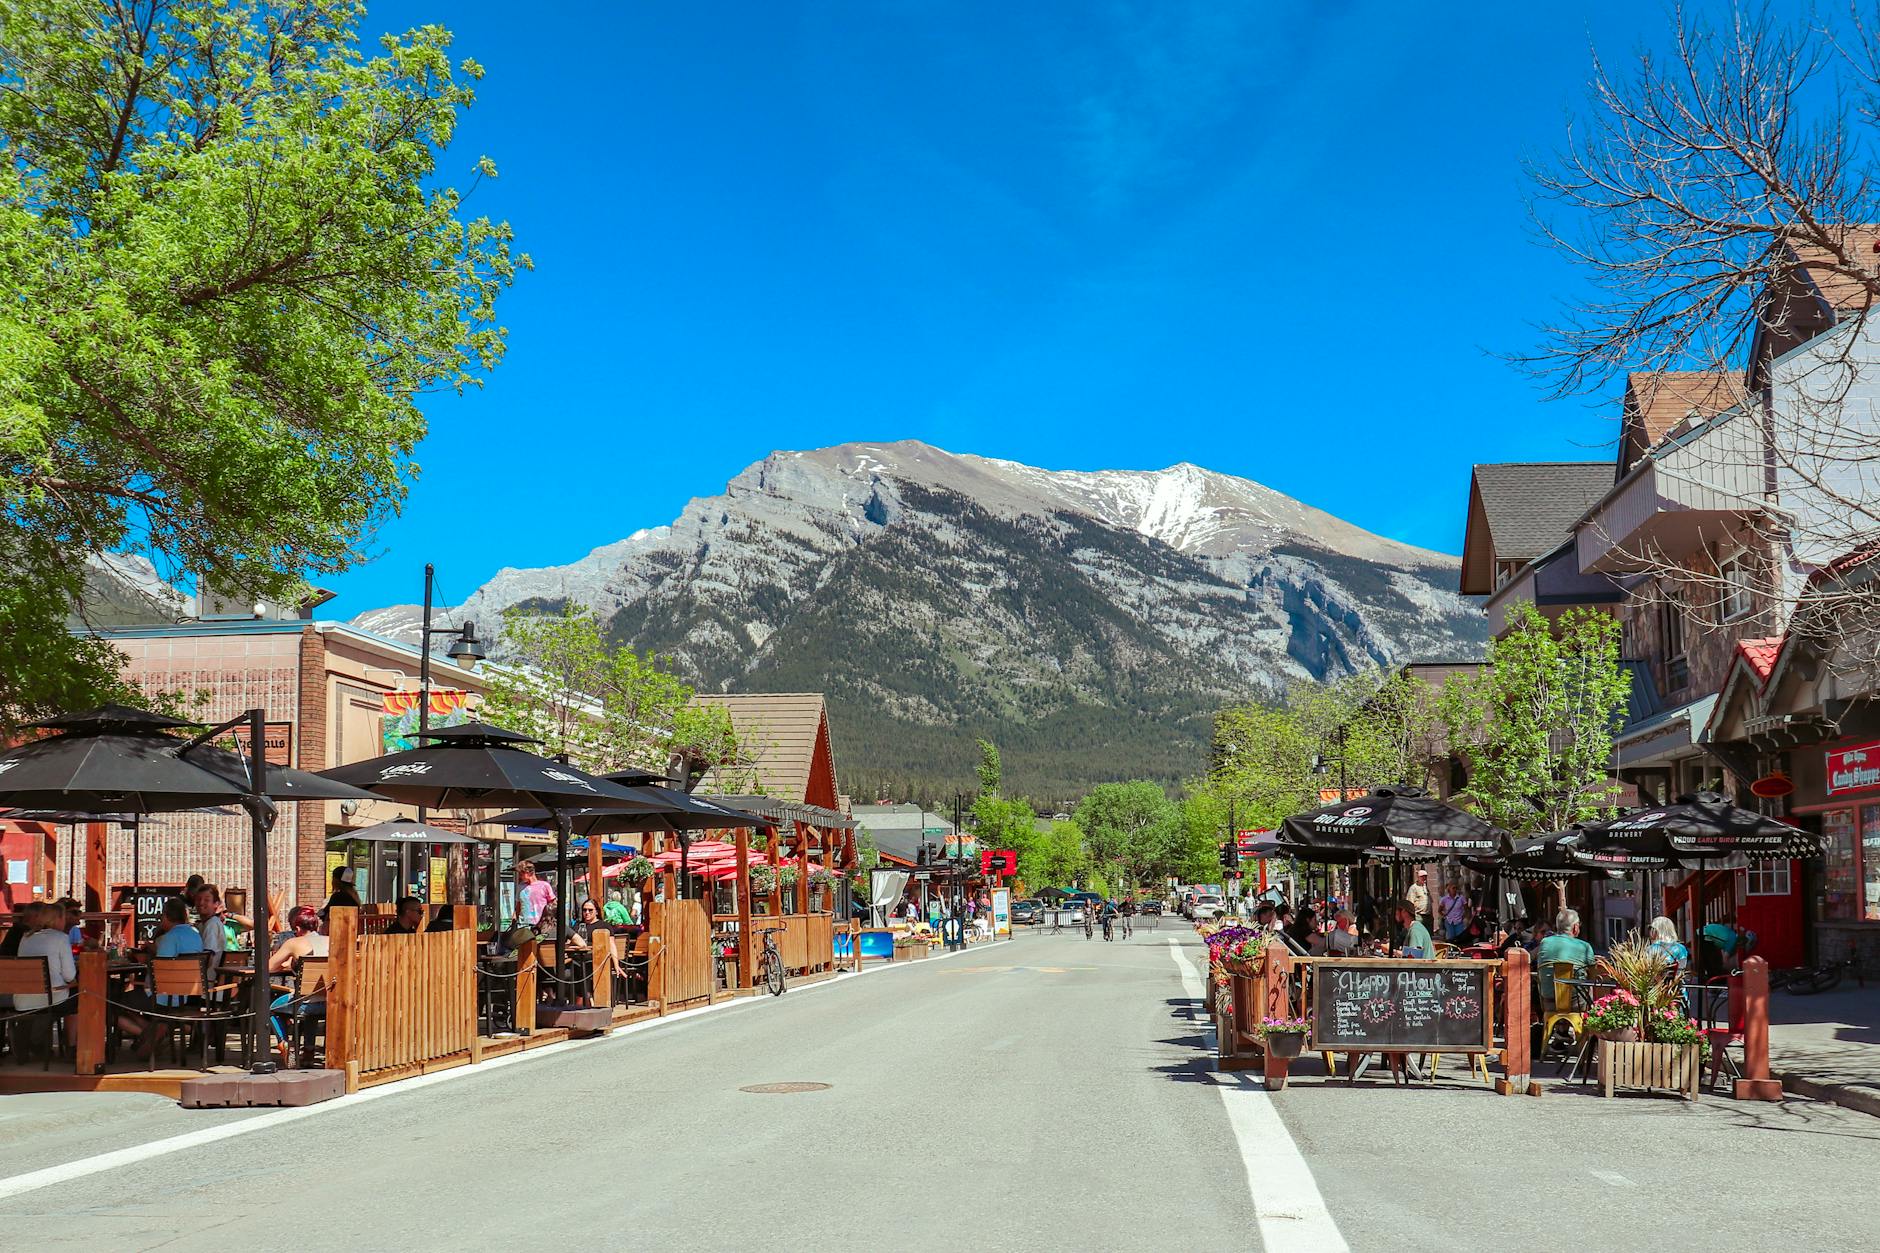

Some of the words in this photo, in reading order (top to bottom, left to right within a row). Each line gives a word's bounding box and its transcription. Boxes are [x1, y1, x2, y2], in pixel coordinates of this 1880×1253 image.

[1313, 814, 1339, 824] BIG
[1334, 817, 1371, 826] ROCK
[1316, 825, 1355, 834] BREWERY
[1391, 835, 1412, 846] PROUD
[1413, 838, 1432, 846] EARLY
[1433, 839, 1448, 847] BIRD
[1453, 840, 1474, 848] CRAFT
[1475, 840, 1493, 848] BEER
[1674, 836, 1696, 844] PROUD
[1697, 836, 1718, 844] EARLY
[1719, 836, 1734, 844] BIRD
[1741, 836, 1763, 844] CRAFT
[1764, 836, 1782, 844] BEER
[1573, 851, 1594, 860] PROUD
[1594, 854, 1612, 862] EARLY
[130, 896, 169, 915] OCA
[1339, 971, 1390, 994] Happy
[1397, 971, 1441, 991] Hour
